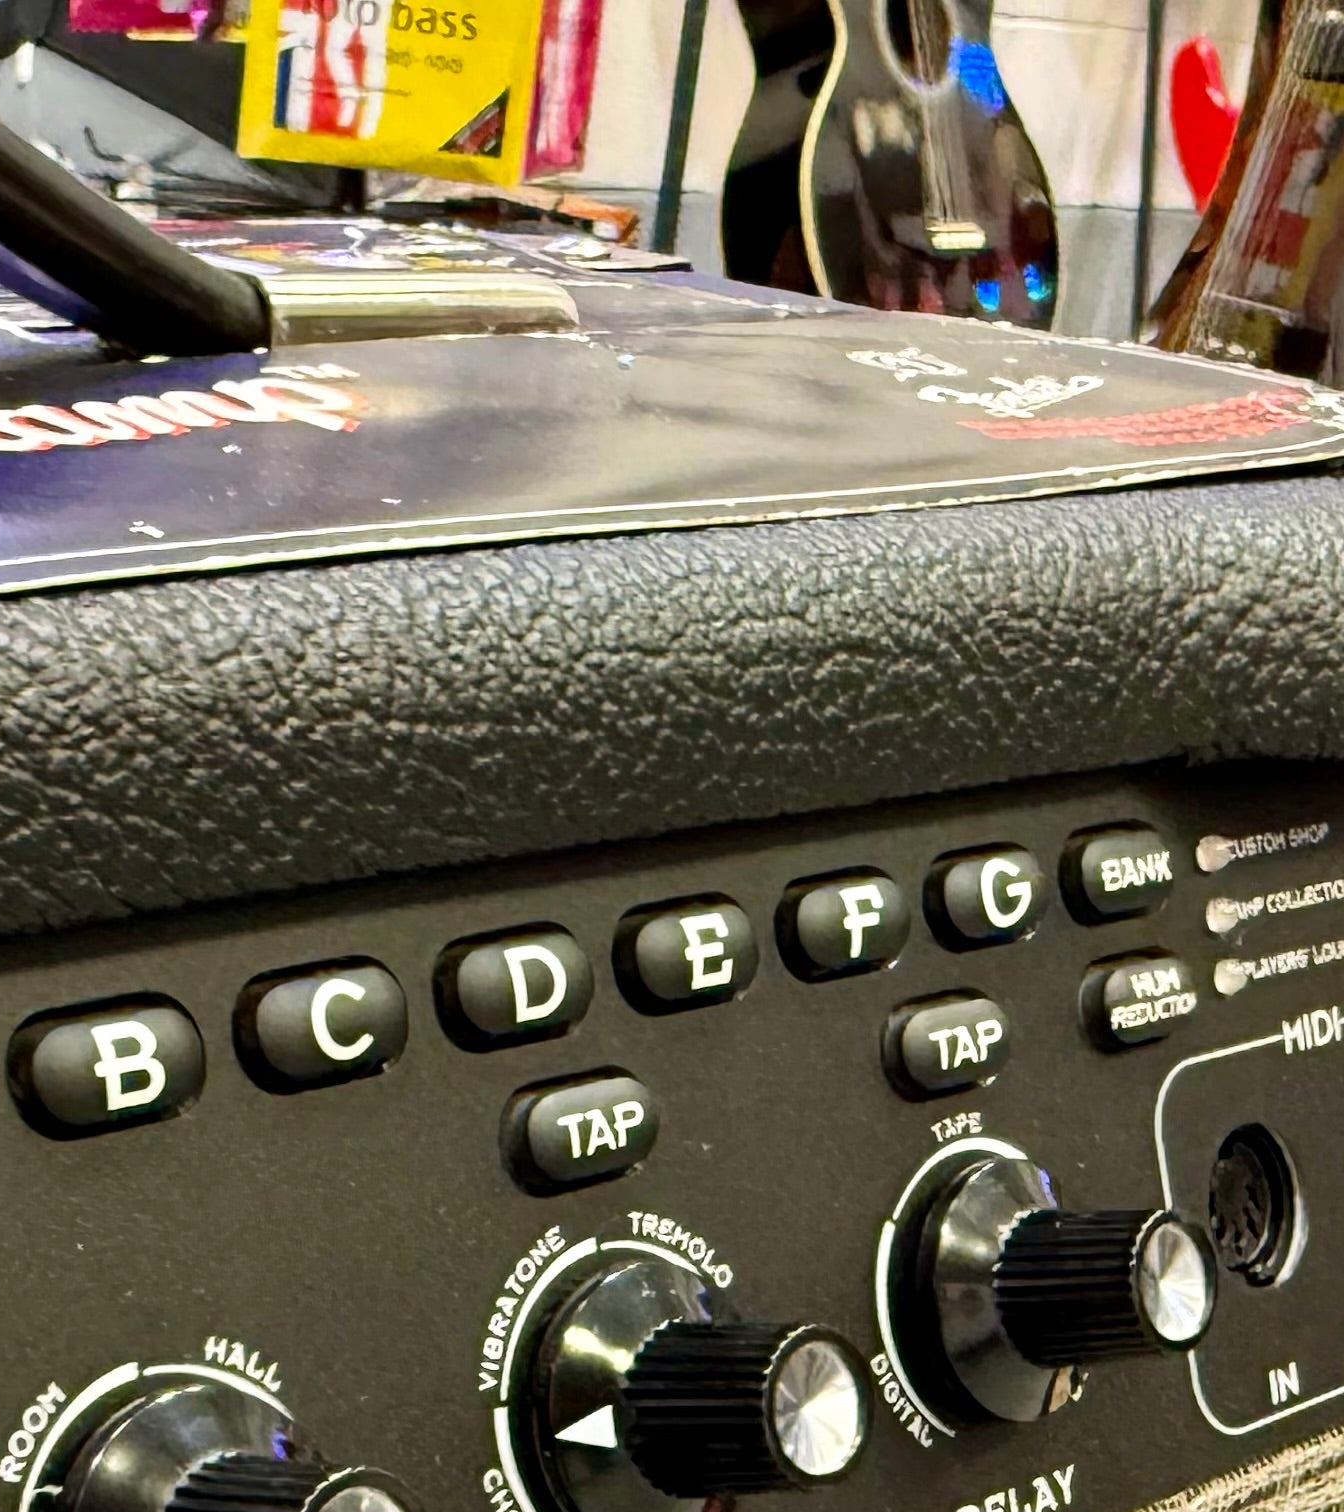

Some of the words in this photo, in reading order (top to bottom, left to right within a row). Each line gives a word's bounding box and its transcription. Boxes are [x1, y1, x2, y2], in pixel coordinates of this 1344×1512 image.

[392, 0, 478, 41] bass
[1288, 822, 1330, 848] SHOP
[979, 857, 1032, 929] G
[1100, 849, 1174, 892] BANK
[679, 912, 735, 990] E
[839, 884, 885, 958] F
[502, 944, 567, 1023] D
[1129, 967, 1181, 999] HUM
[311, 978, 375, 1061] C
[929, 1018, 1003, 1071] TAP
[1282, 1007, 1343, 1055] MIDI
[90, 1020, 166, 1111] B
[557, 1100, 644, 1160] TAP
[930, 1112, 983, 1143] TAPE
[627, 1211, 734, 1289] TREMOLO
[478, 1225, 567, 1391] VIBRATONE
[204, 1336, 282, 1393] HALL
[1268, 1361, 1300, 1405] IN
[869, 1353, 934, 1449] DIGITAL
